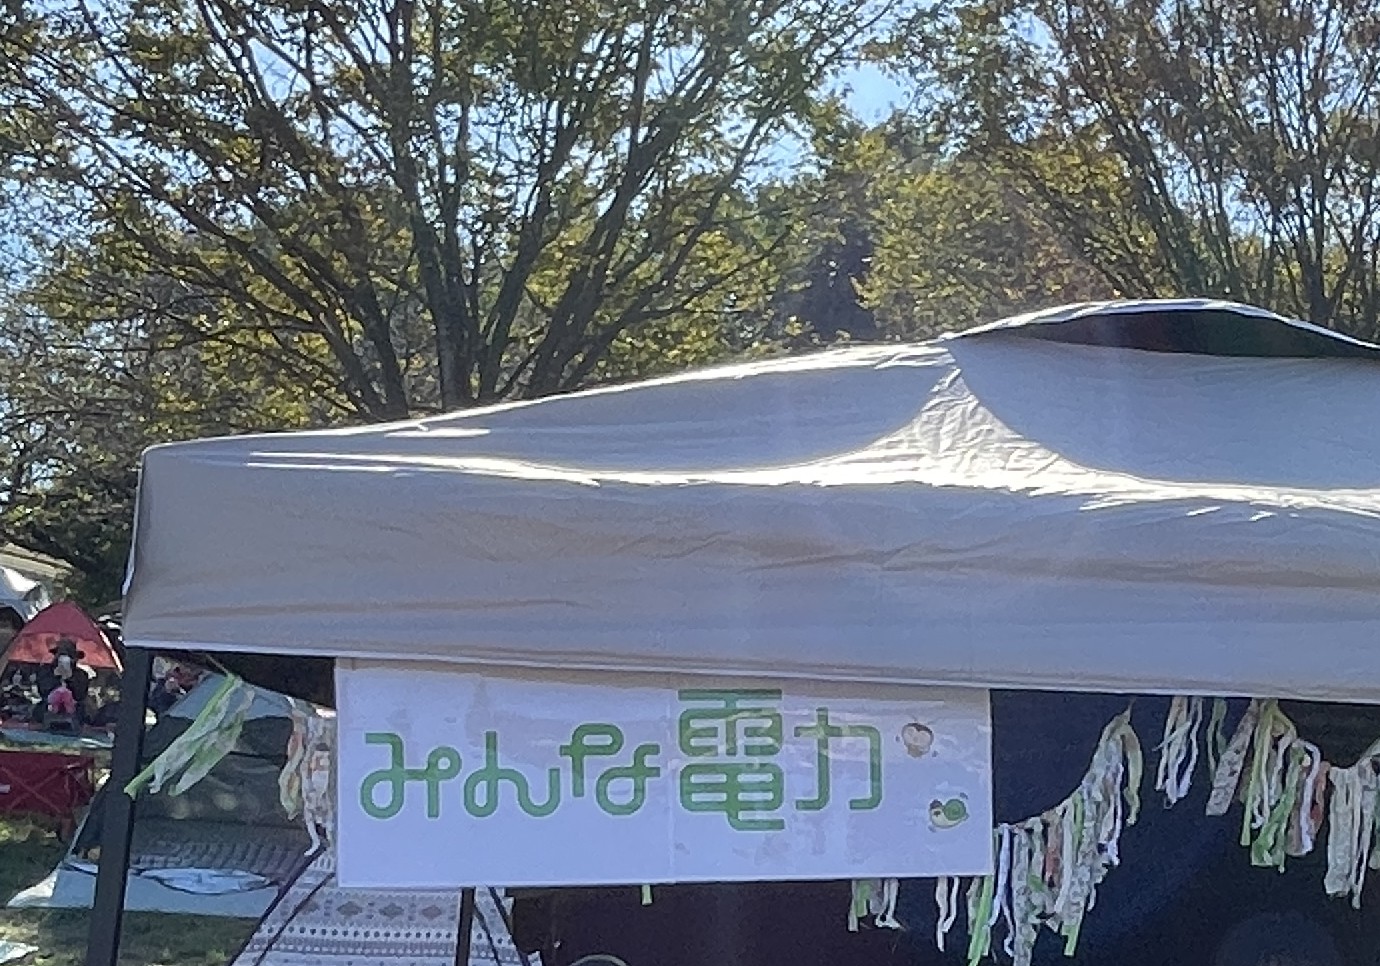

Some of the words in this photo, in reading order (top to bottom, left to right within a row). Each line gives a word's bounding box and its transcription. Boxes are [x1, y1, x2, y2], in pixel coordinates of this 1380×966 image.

[359, 688, 884, 831] みんな電力
